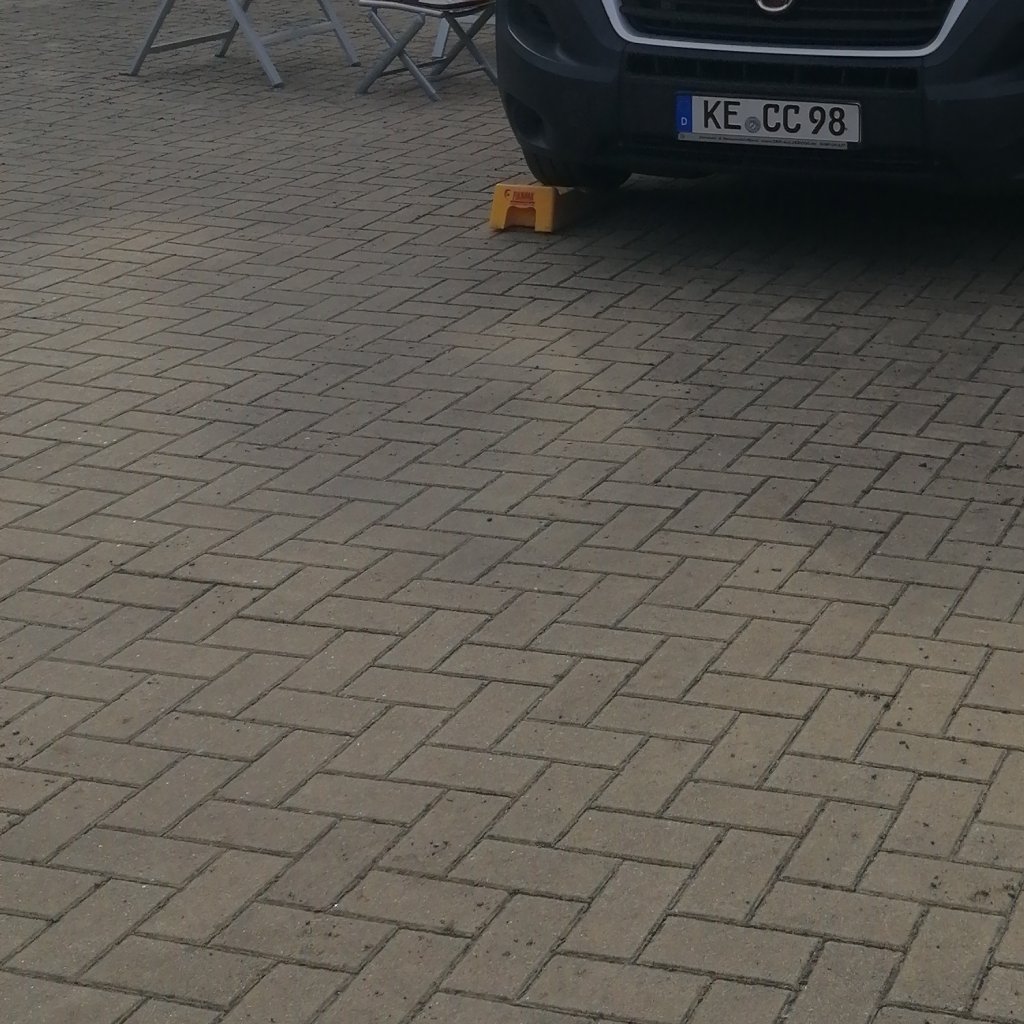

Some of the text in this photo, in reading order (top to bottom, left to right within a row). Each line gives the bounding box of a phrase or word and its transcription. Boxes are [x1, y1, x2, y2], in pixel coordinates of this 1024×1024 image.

[680, 100, 847, 136] D KE CC 98
